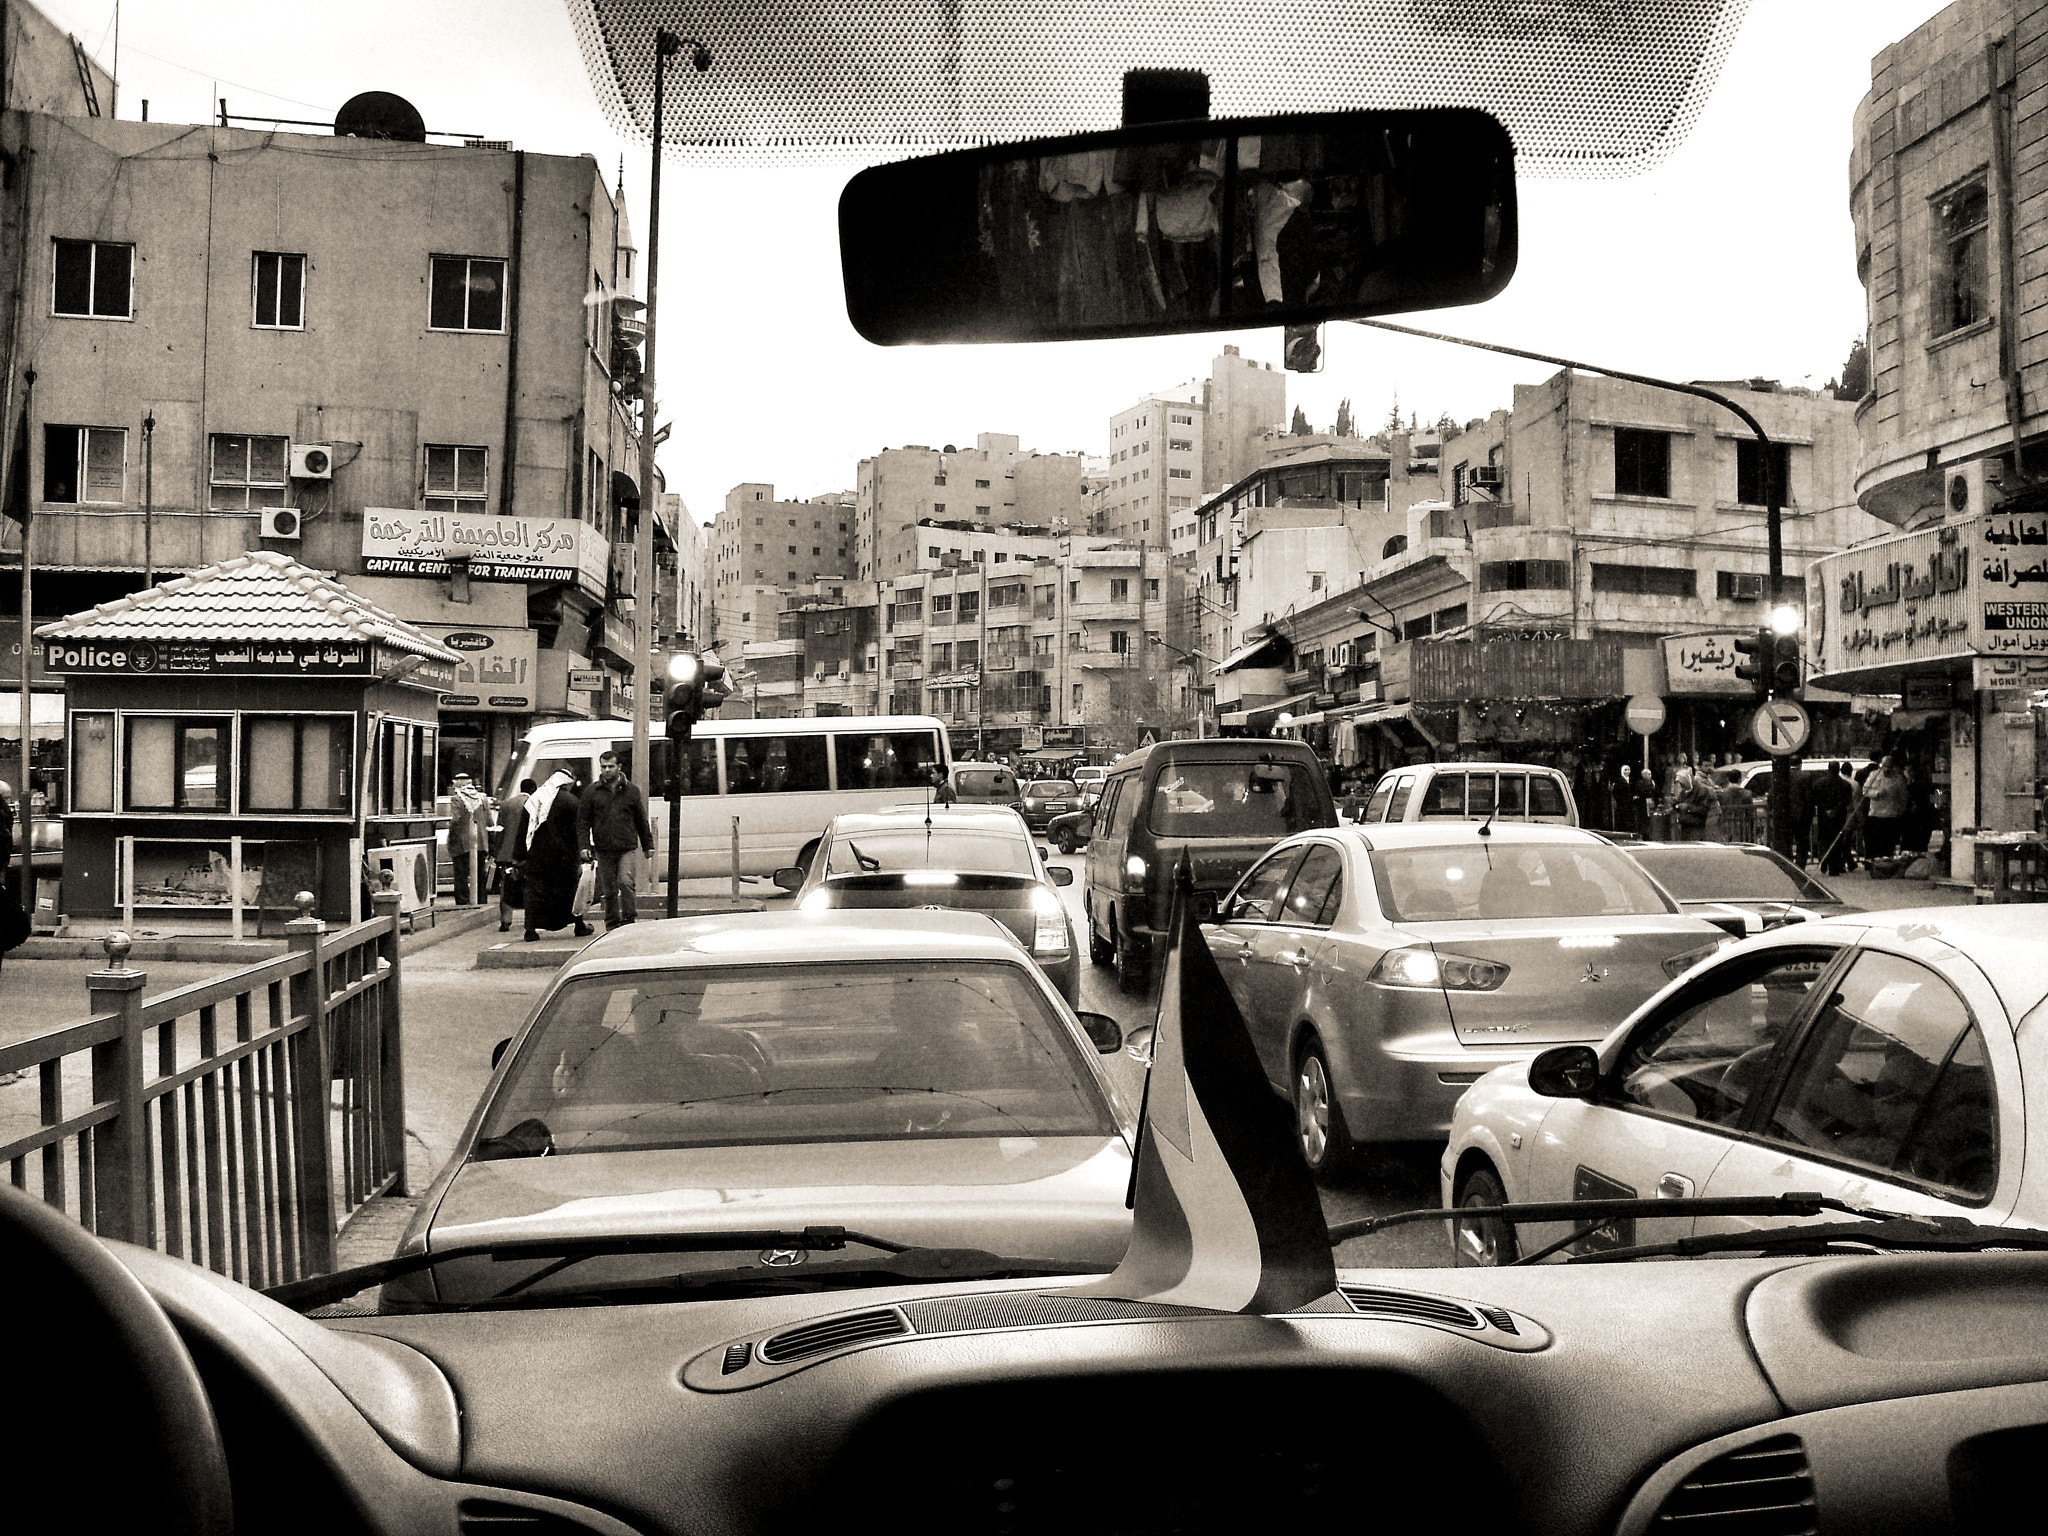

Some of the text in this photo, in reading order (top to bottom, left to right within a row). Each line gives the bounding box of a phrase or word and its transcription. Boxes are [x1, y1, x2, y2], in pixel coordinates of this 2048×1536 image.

[369, 515, 574, 554] مركز العاصمة للترجمة
[1984, 517, 2048, 552] لعالمية
[496, 550, 524, 562] جمعية
[366, 559, 573, 581] CAPITAL CENT FOR TRANSLATION
[1982, 557, 2048, 589] لصرافة
[1985, 603, 2048, 616] WESTERN
[2006, 616, 2048, 629] UNION
[1988, 633, 2048, 651] ويل أموال
[49, 645, 127, 667] Police
[214, 645, 364, 671] الشرطة في خدمة الشعب
[458, 656, 527, 684] القاد
